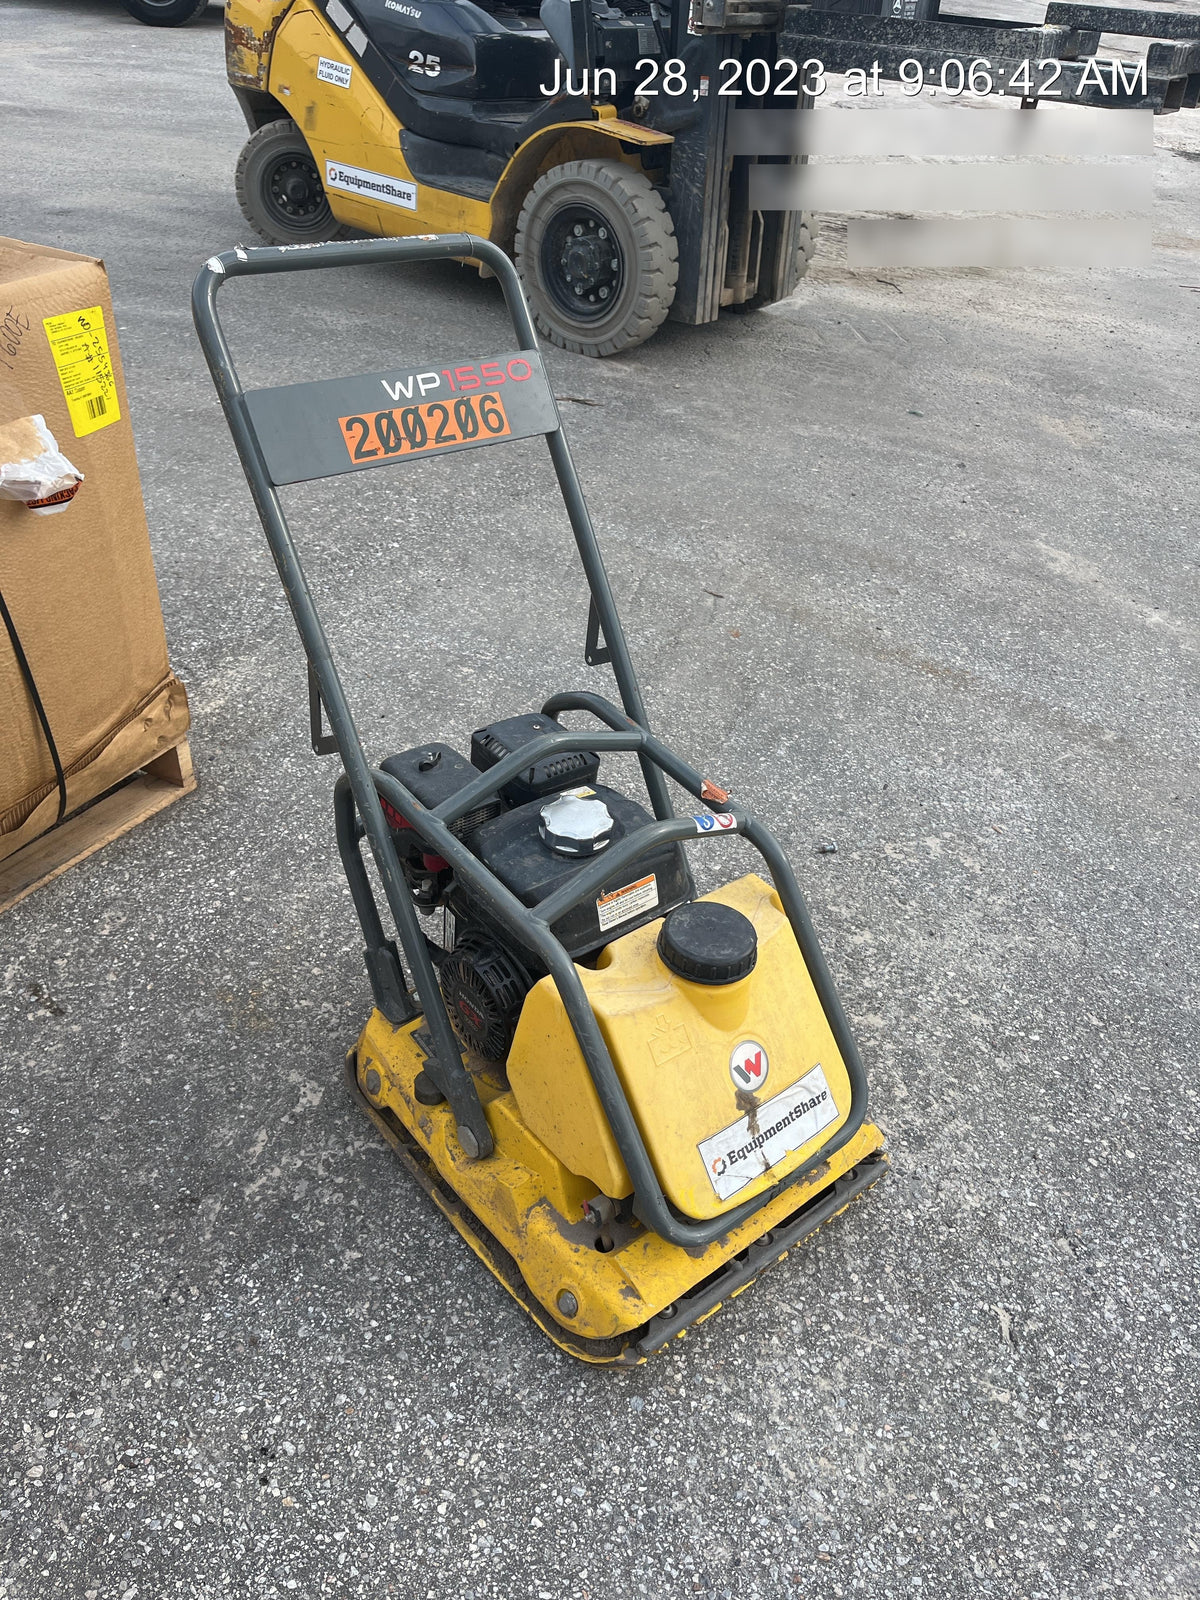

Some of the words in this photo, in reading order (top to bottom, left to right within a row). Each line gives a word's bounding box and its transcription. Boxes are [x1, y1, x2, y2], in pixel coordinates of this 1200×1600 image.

[385, 0, 422, 19] KOMATSU
[318, 69, 334, 81] FLUID
[334, 73, 349, 85] ONLY
[320, 60, 351, 76] HYDRAULIC
[408, 50, 441, 77] 25
[338, 171, 413, 201] EquipmentShare
[381, 358, 533, 401] WP1550
[345, 394, 506, 461] 200206
[726, 1090, 828, 1166] EquipmentShare
